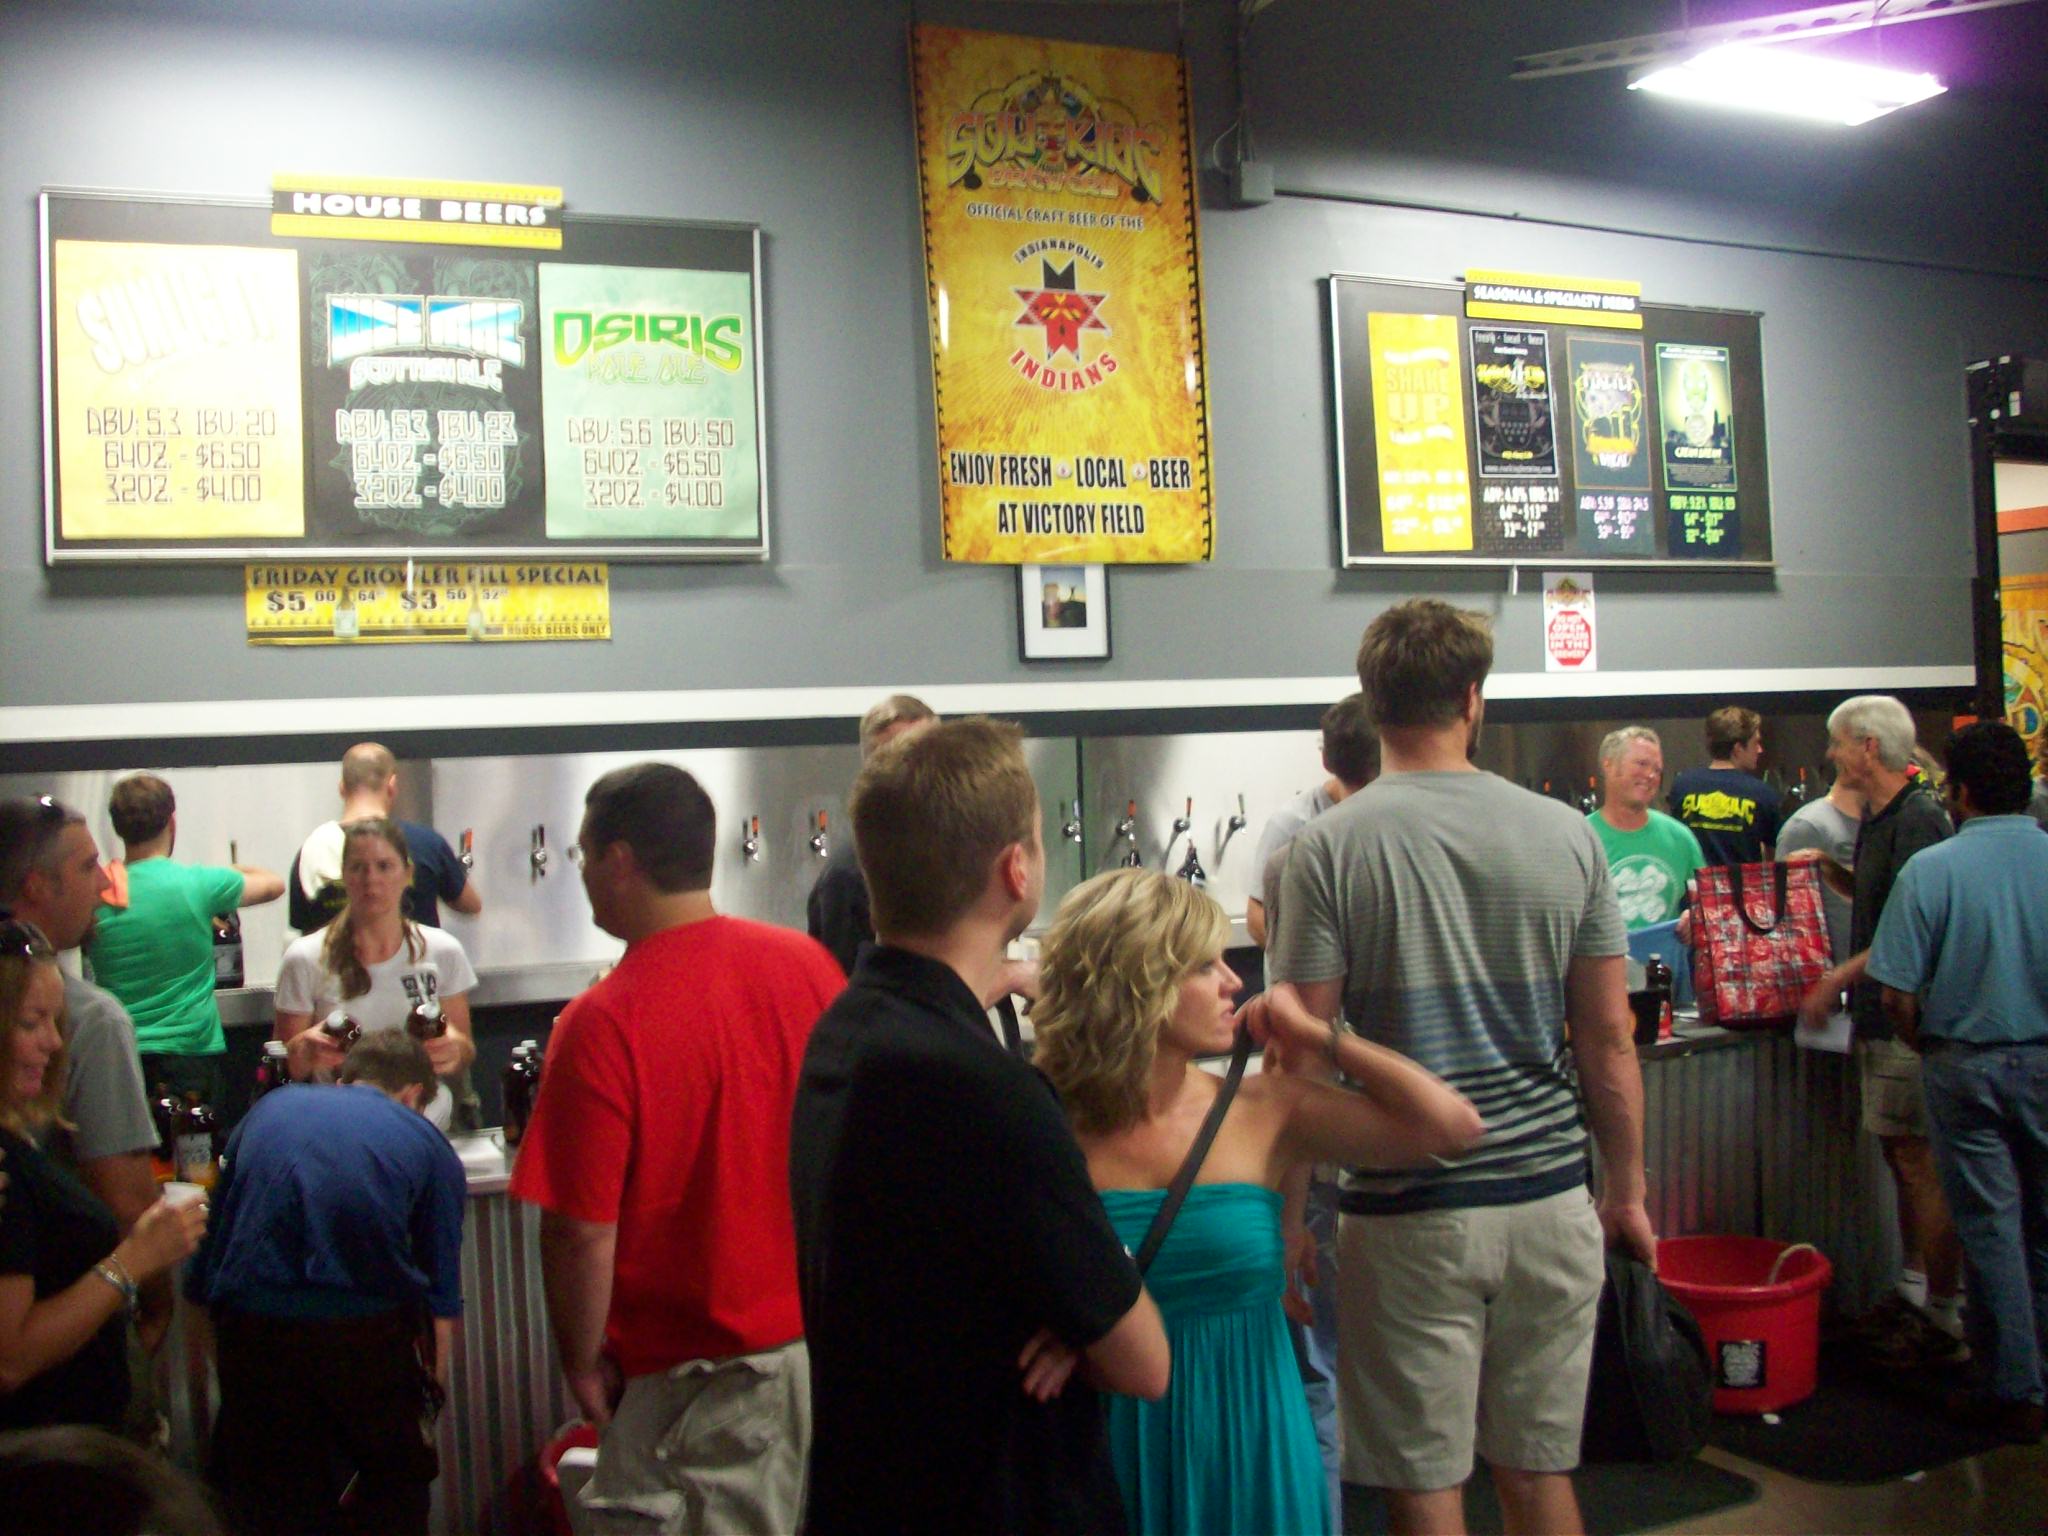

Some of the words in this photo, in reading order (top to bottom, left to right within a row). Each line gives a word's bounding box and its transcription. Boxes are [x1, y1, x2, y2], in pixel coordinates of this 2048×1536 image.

[947, 111, 1036, 188] SUN
[1065, 118, 1163, 208] KING
[293, 192, 421, 219] HOUSE
[440, 200, 546, 226] BEERS
[967, 202, 1023, 220] OFFICIAL
[1026, 207, 1064, 224] CRAFT
[1068, 211, 1098, 227] BEER
[1100, 213, 1118, 227] OF
[1120, 215, 1144, 232] THE
[1013, 238, 1104, 269] INDIANAPOLIS
[553, 310, 744, 374] OSIRIS
[656, 352, 708, 385] ALE
[1009, 349, 1118, 391] INDIANS
[147, 407, 181, 436] 5.3
[246, 410, 276, 436] 20
[1386, 393, 1450, 424] UP
[391, 409, 430, 442] 5.3
[484, 411, 518, 445] 23
[620, 418, 651, 445] 5.6
[707, 420, 734, 447] 50
[196, 442, 261, 469] $6.50
[438, 442, 504, 474] $6.50
[664, 451, 721, 477] $6.50
[950, 452, 994, 485] ENJOY
[1000, 456, 1051, 487] FRESH
[1076, 457, 1127, 488] LOCAL
[1150, 459, 1191, 489] BEER
[196, 474, 261, 502] $4.00
[439, 474, 505, 508] $4.00
[665, 480, 723, 507] $4.00
[999, 504, 1018, 534] AT
[1023, 504, 1095, 534] VICTORY
[1101, 504, 1144, 534] FIELD
[253, 567, 339, 585] FRIDAY
[347, 567, 459, 585] GROWLER
[467, 567, 510, 584] FILL
[516, 567, 605, 584] SPECIAL
